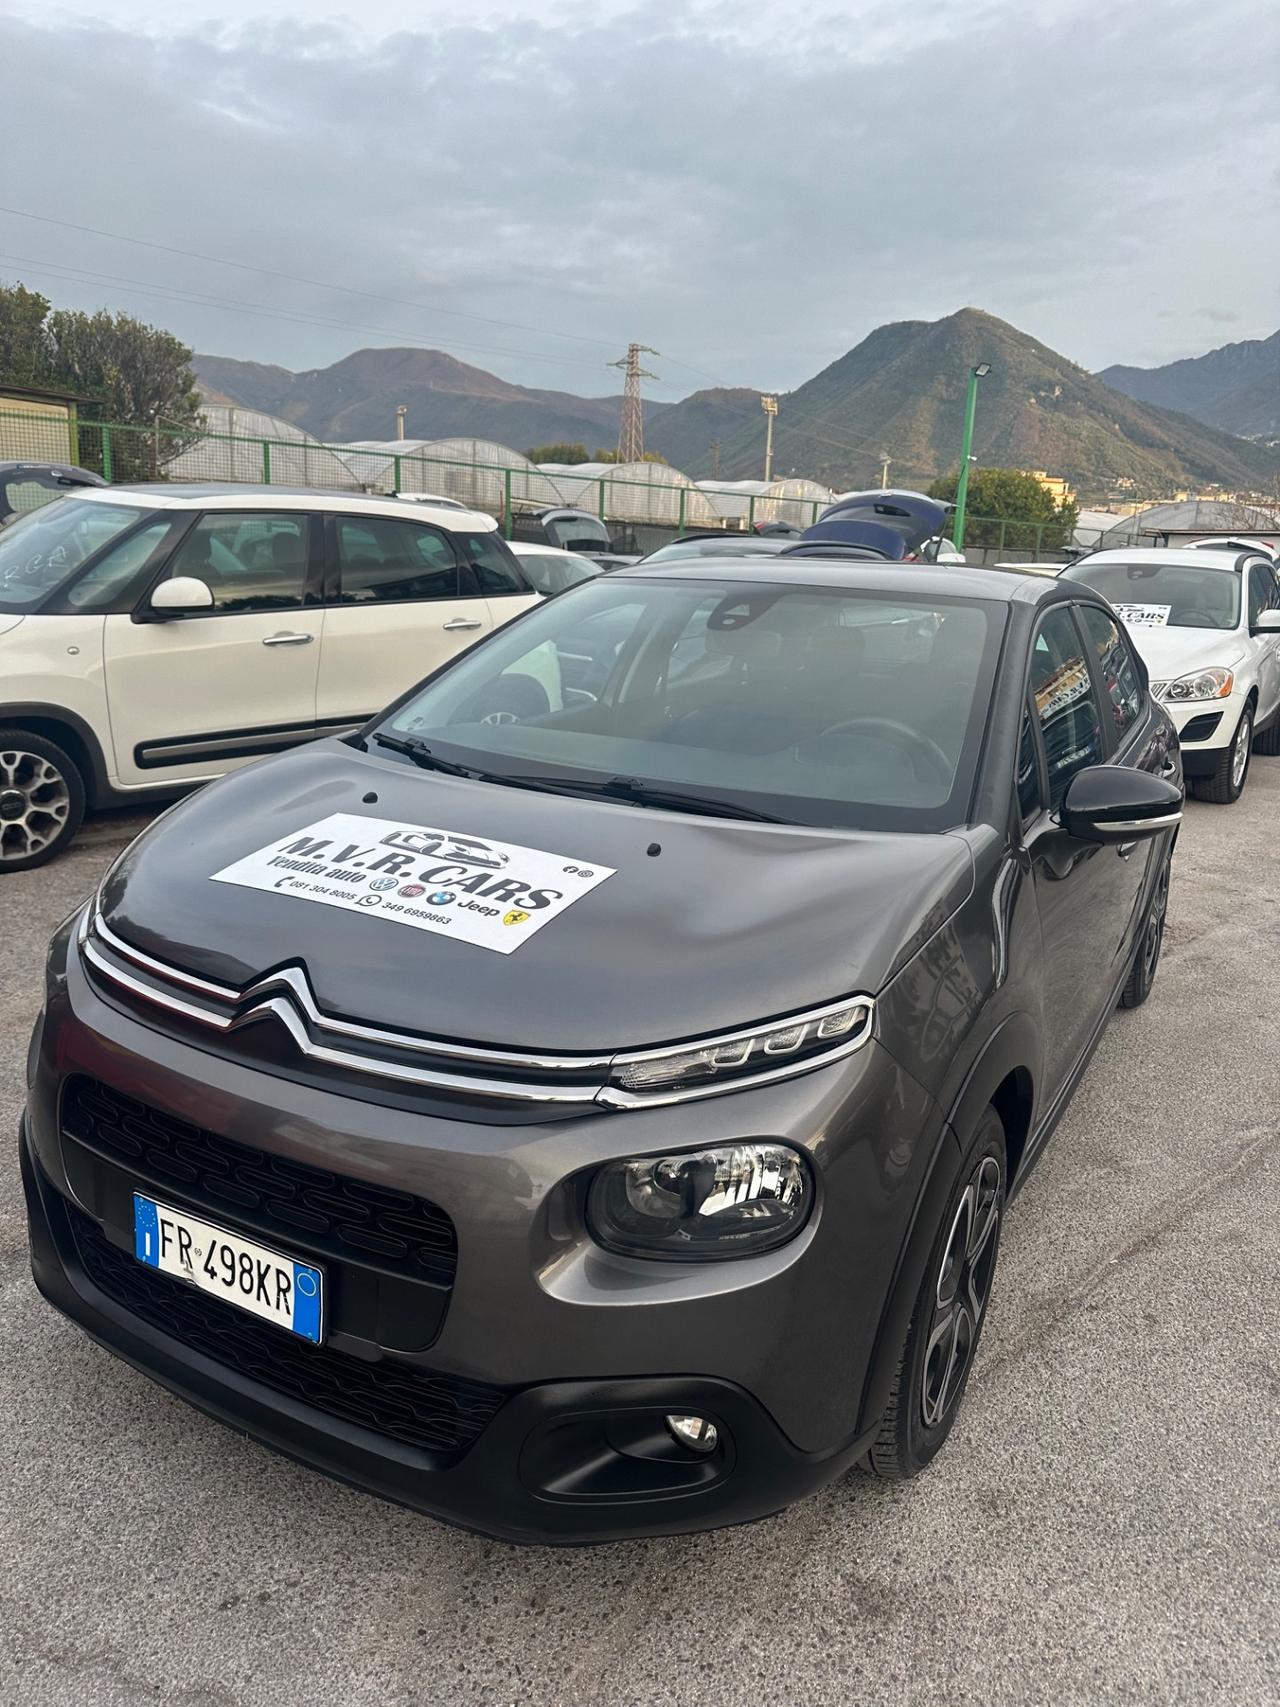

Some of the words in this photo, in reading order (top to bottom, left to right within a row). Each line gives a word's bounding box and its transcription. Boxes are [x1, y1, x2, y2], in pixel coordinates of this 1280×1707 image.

[266, 855, 328, 875] Vendita
[324, 868, 367, 884] auto
[289, 880, 309, 890] 081
[308, 885, 332, 896] 304
[329, 889, 357, 901] 8005
[382, 901, 405, 912] 349
[403, 907, 453, 926] 6959863
[457, 900, 501, 917] Jeep
